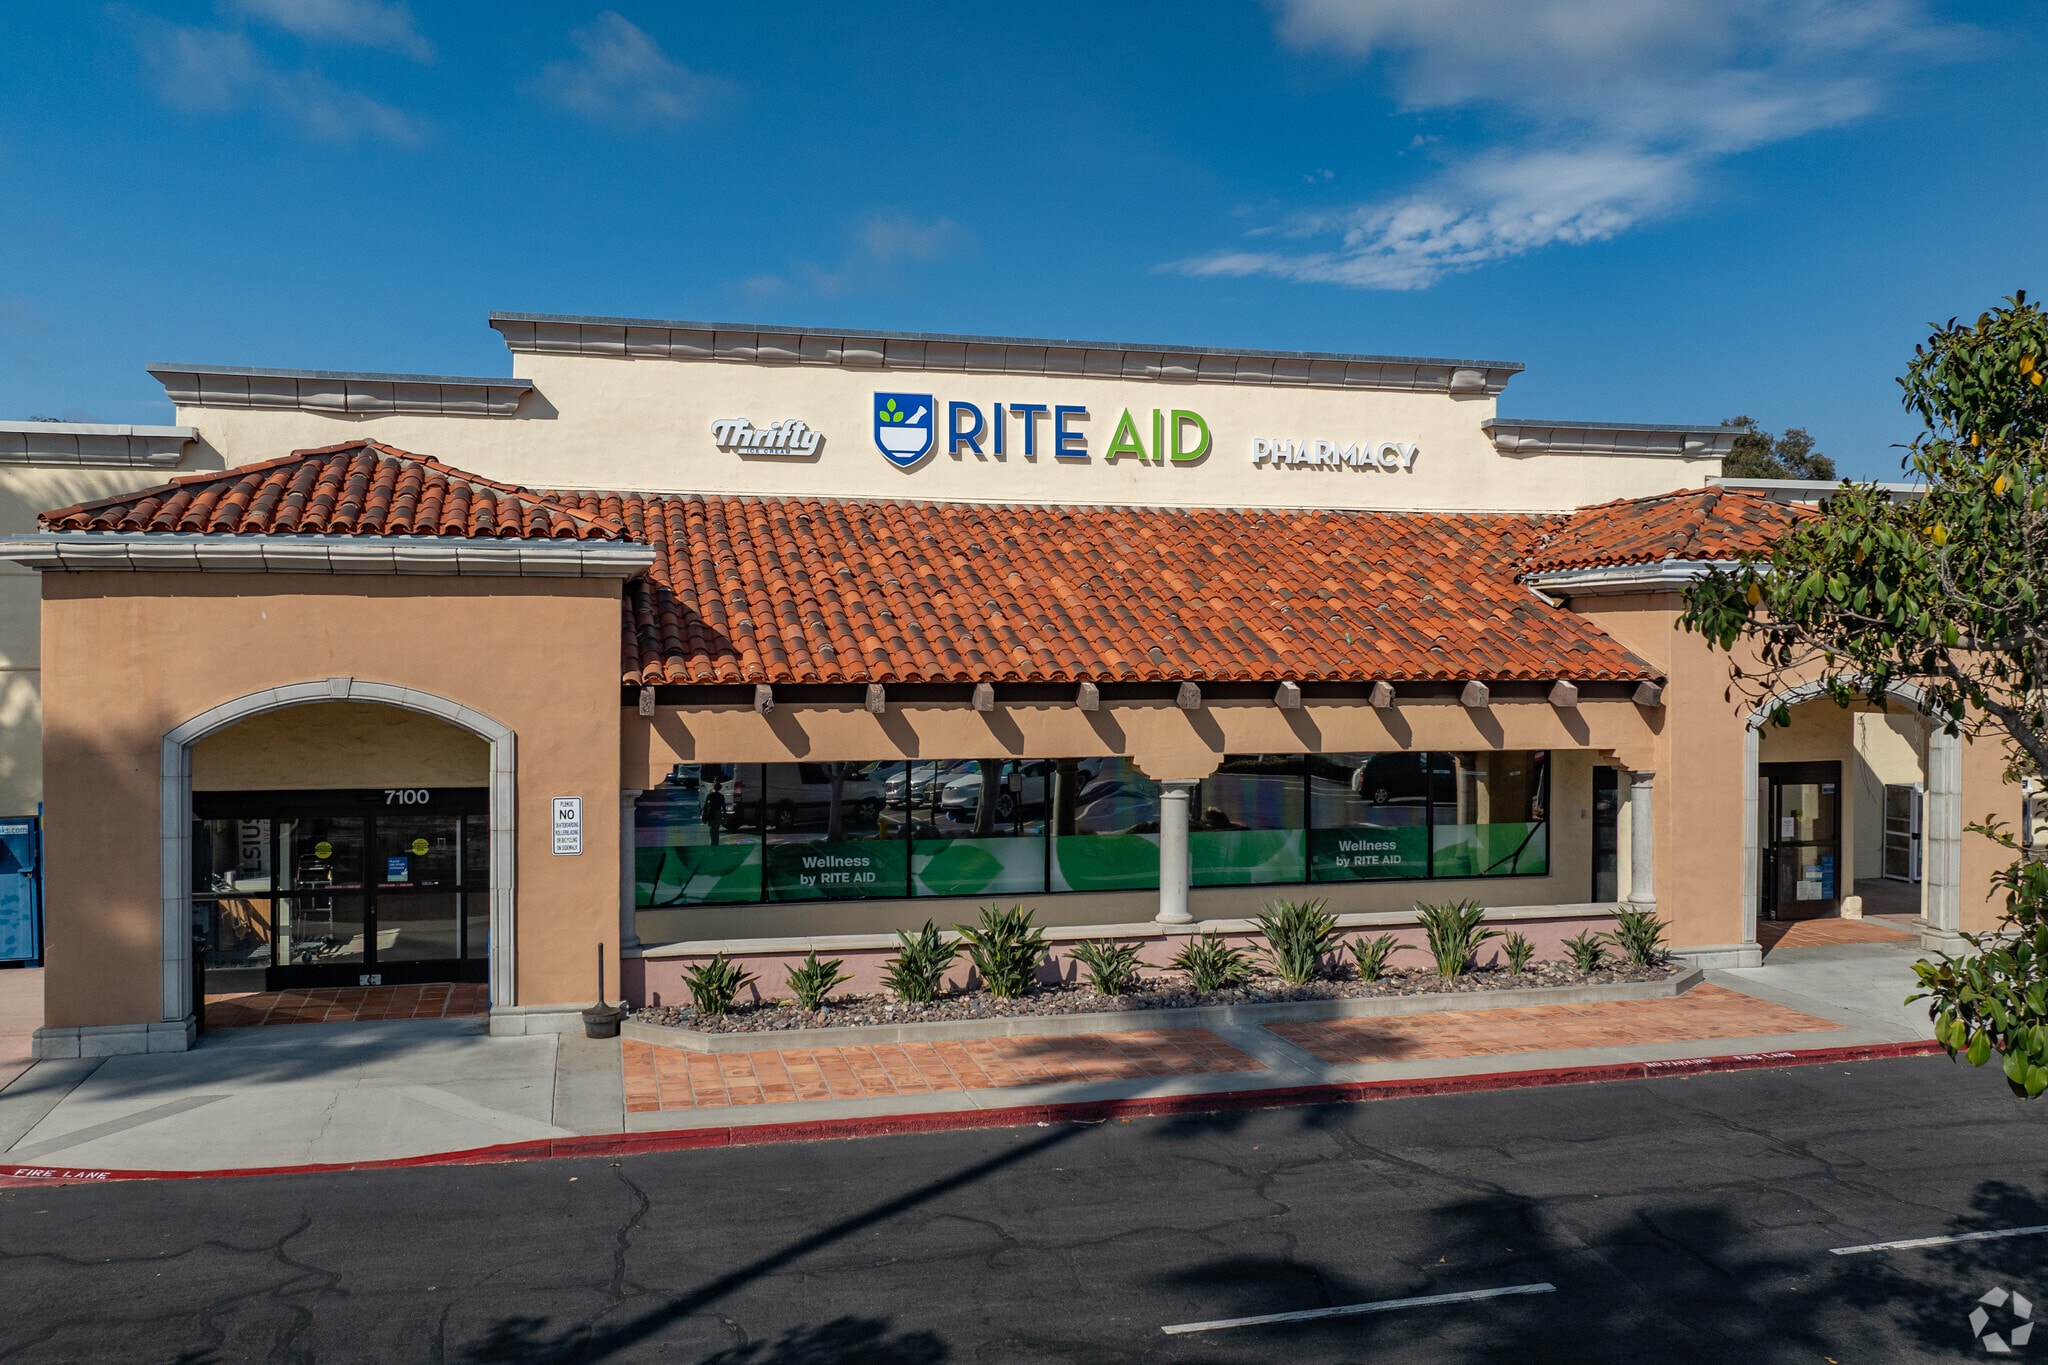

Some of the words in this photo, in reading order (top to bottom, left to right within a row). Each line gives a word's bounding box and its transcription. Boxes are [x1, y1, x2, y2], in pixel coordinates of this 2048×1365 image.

[711, 418, 821, 455] Thrifty
[948, 400, 1088, 457] RITE
[1103, 407, 1210, 461] AID
[1253, 438, 1417, 467] PHARMACY
[384, 789, 430, 805] 7100
[559, 809, 575, 820] NO
[0, 825, 28, 834] ks.com
[1339, 840, 1397, 852] Wellness
[802, 856, 870, 868] Wellness
[1336, 856, 1350, 868] by
[1354, 855, 1379, 865] RITE
[1382, 855, 1402, 864] AID
[800, 874, 816, 887] by
[821, 872, 850, 883] RITE
[853, 872, 876, 882] AID
[13, 1168, 57, 1177] FIRE
[62, 1171, 111, 1180] LANE
